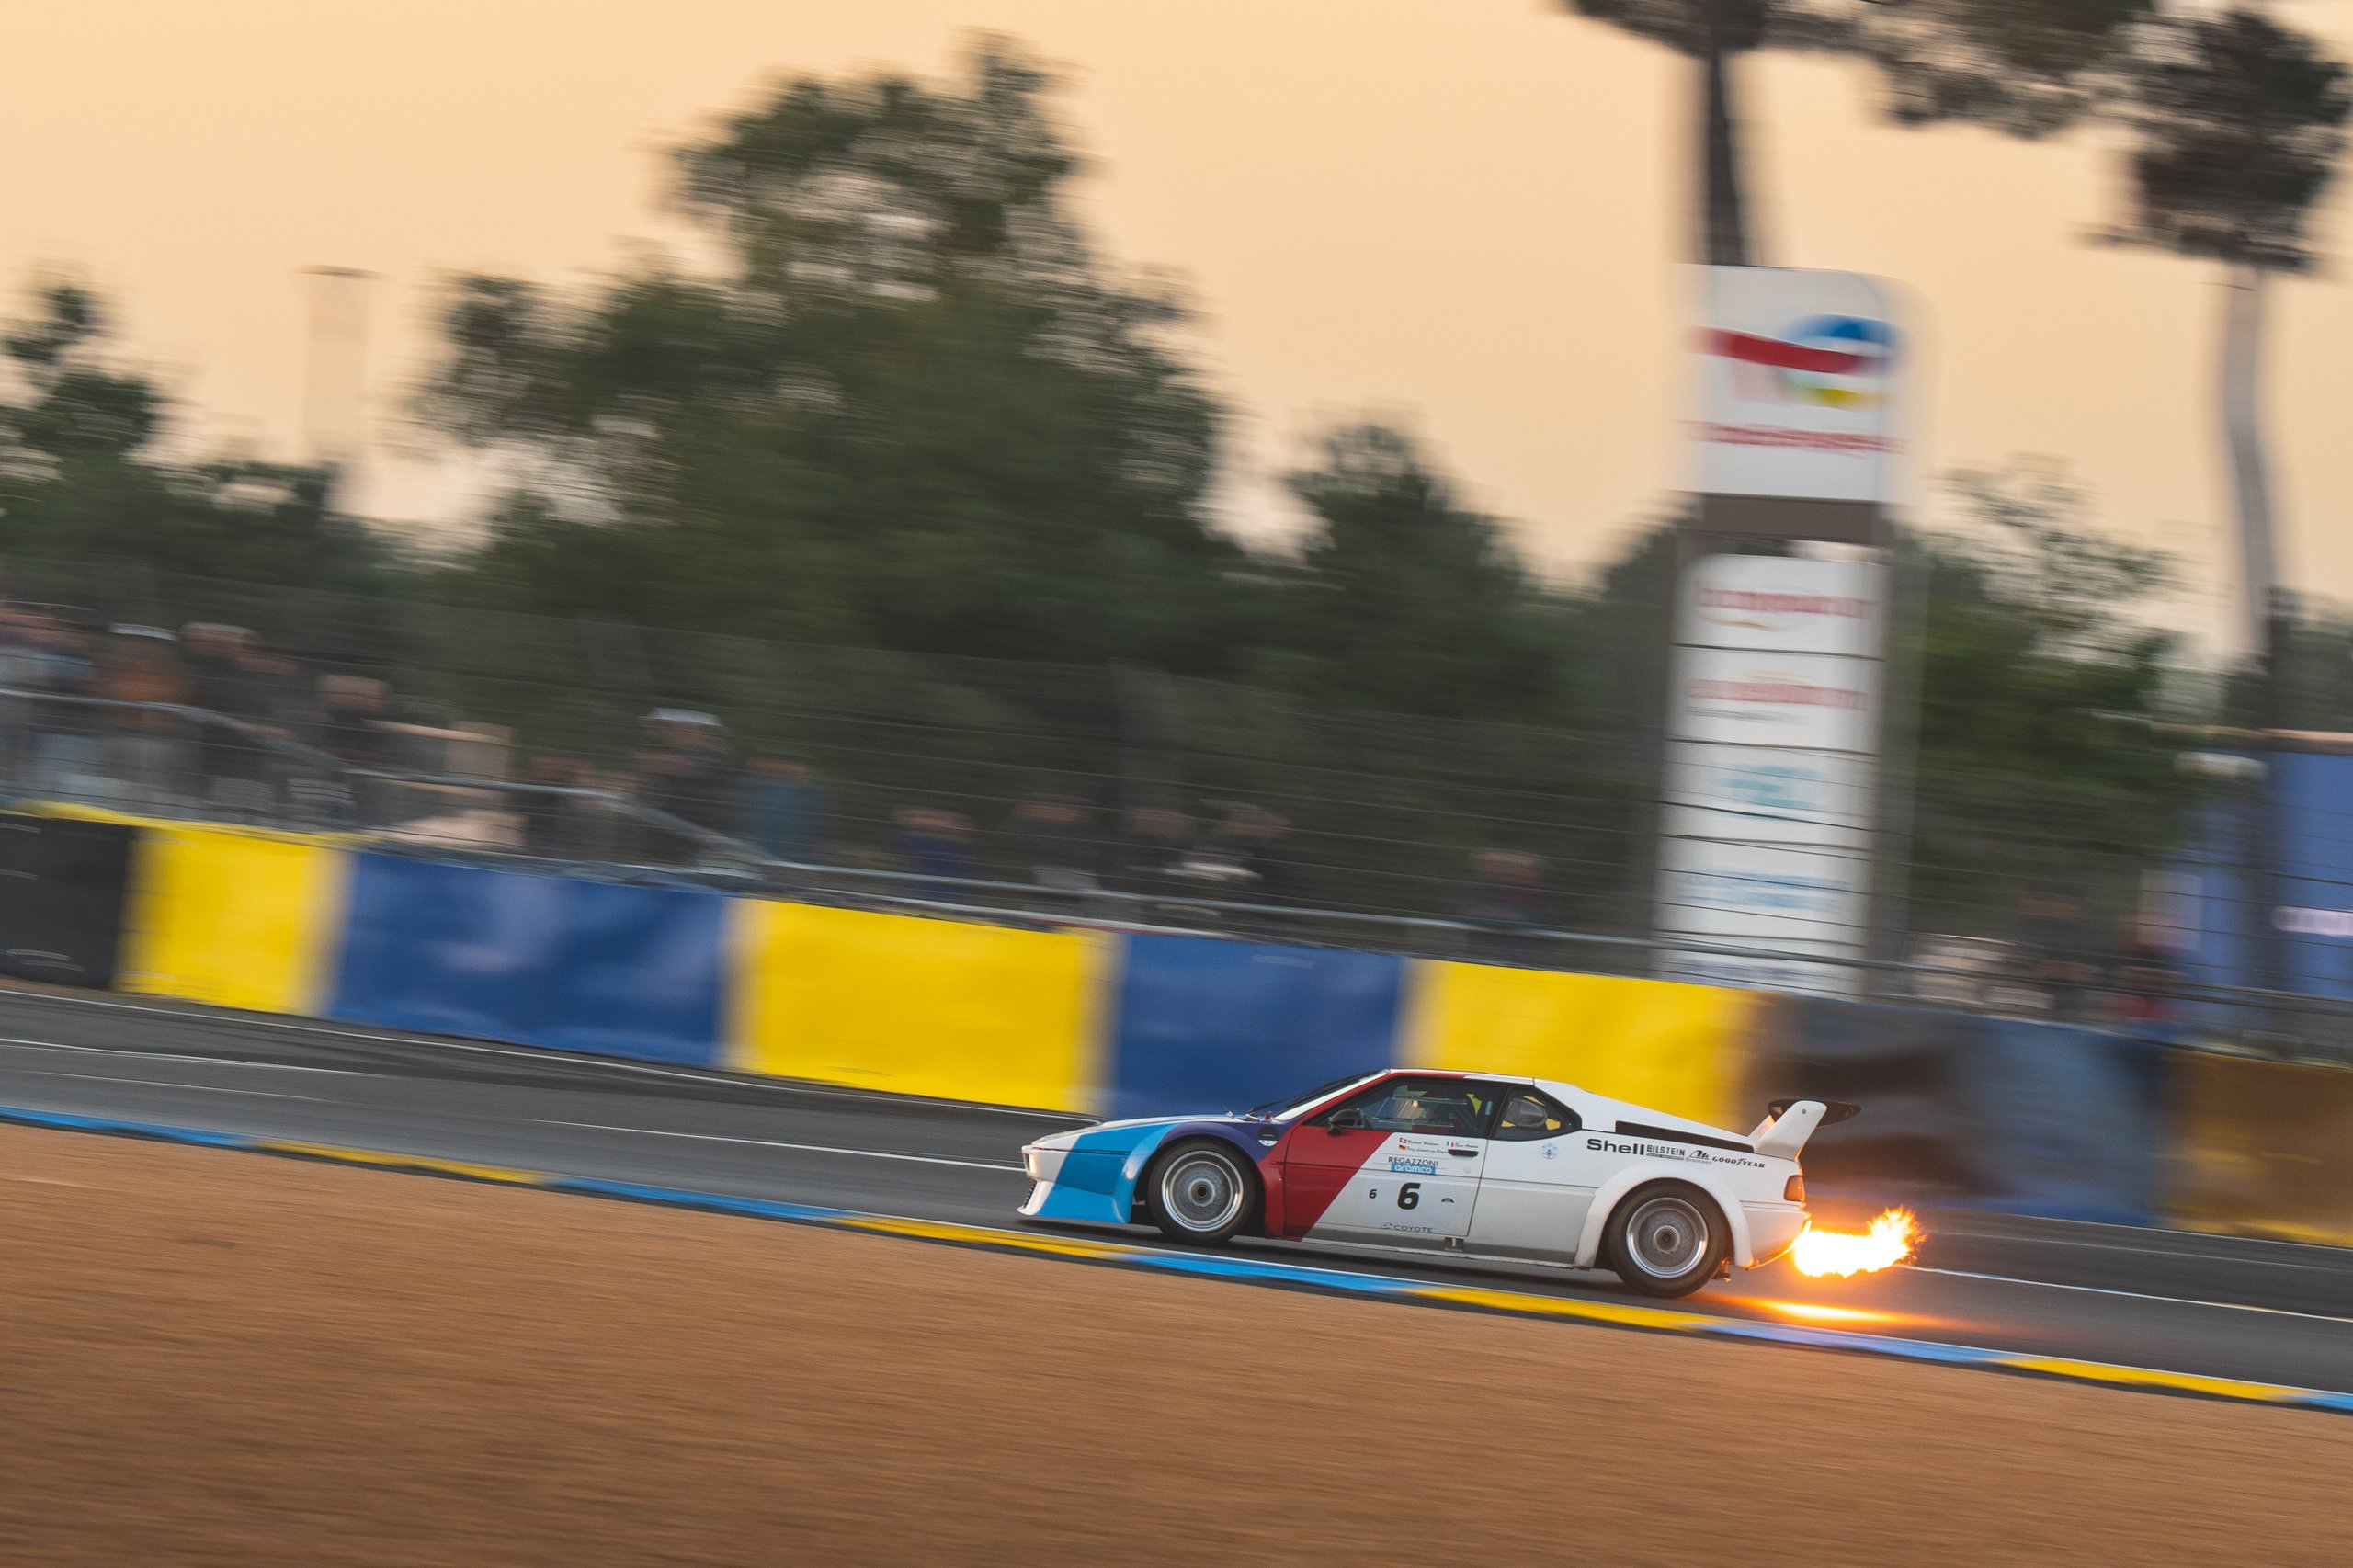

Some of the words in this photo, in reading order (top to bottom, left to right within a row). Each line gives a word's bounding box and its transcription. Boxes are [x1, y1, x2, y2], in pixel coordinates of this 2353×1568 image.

[1586, 1139, 1643, 1155] Shell
[1646, 1144, 1685, 1155] BILSTEIN
[1388, 1156, 1439, 1167] REGAZZONI
[1711, 1156, 1766, 1169] GOODYEAR
[1394, 1165, 1432, 1174] aramco
[1369, 1188, 1377, 1199] 6
[1397, 1182, 1421, 1210] 6
[1393, 1224, 1434, 1233] COYOTE
